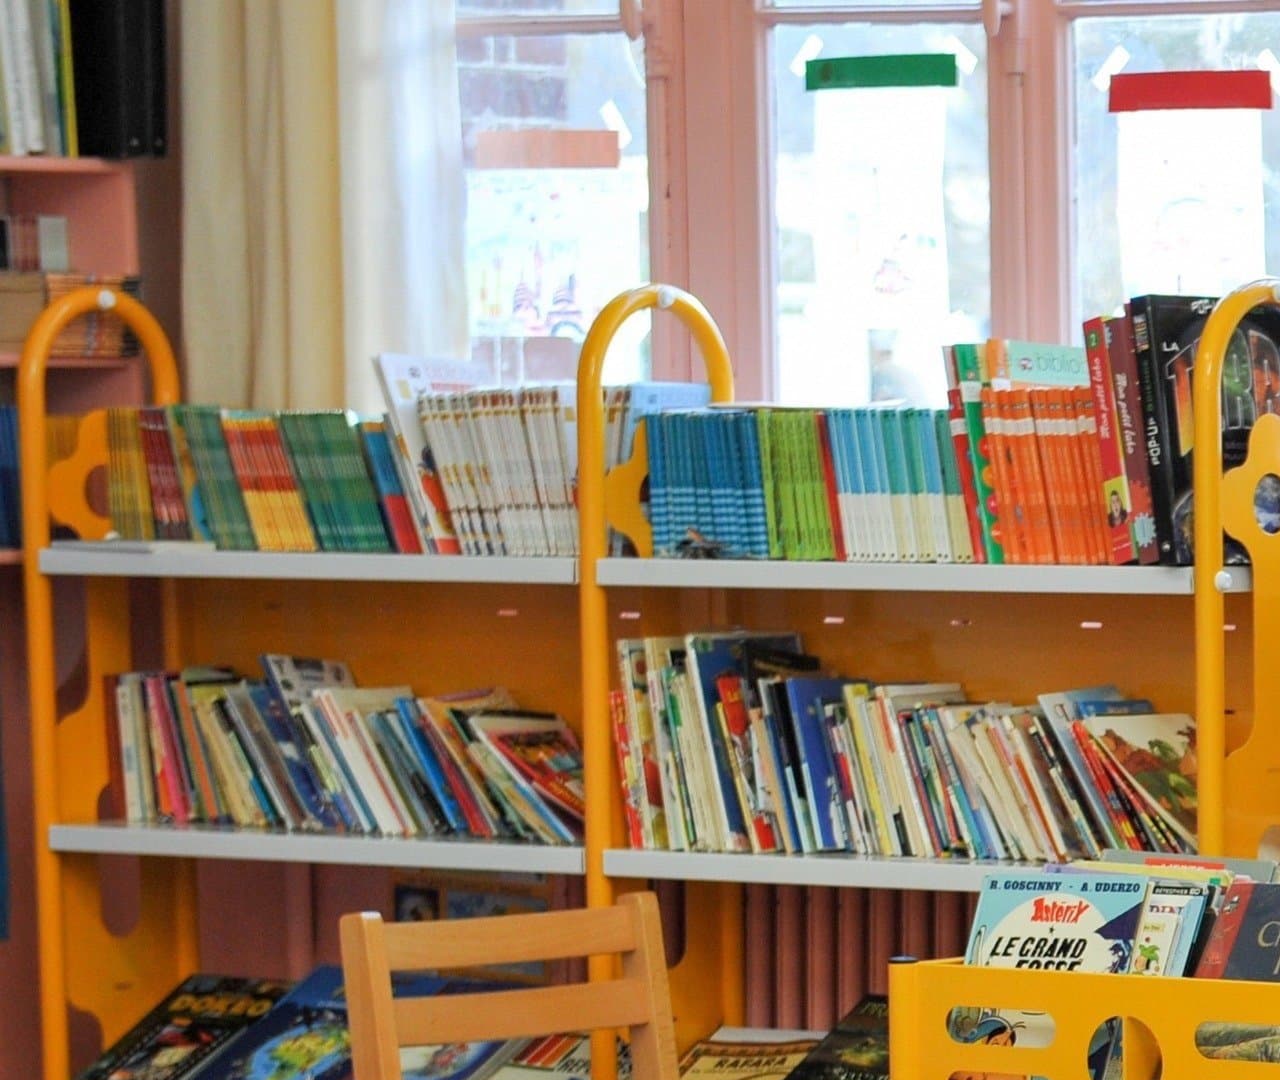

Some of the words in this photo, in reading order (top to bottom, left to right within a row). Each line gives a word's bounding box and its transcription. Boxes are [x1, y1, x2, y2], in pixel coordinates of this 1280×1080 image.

[1162, 341, 1180, 352] LA
[1036, 352, 1081, 374] biblio
[989, 879, 1001, 891] R.
[1003, 880, 1063, 892] GOSCINNY
[1080, 881, 1093, 892] A.
[1094, 882, 1141, 893] UDERZO
[989, 936, 1021, 958] LE
[1018, 936, 1088, 959] GRAND
[713, 1056, 789, 1070] RAFARA
